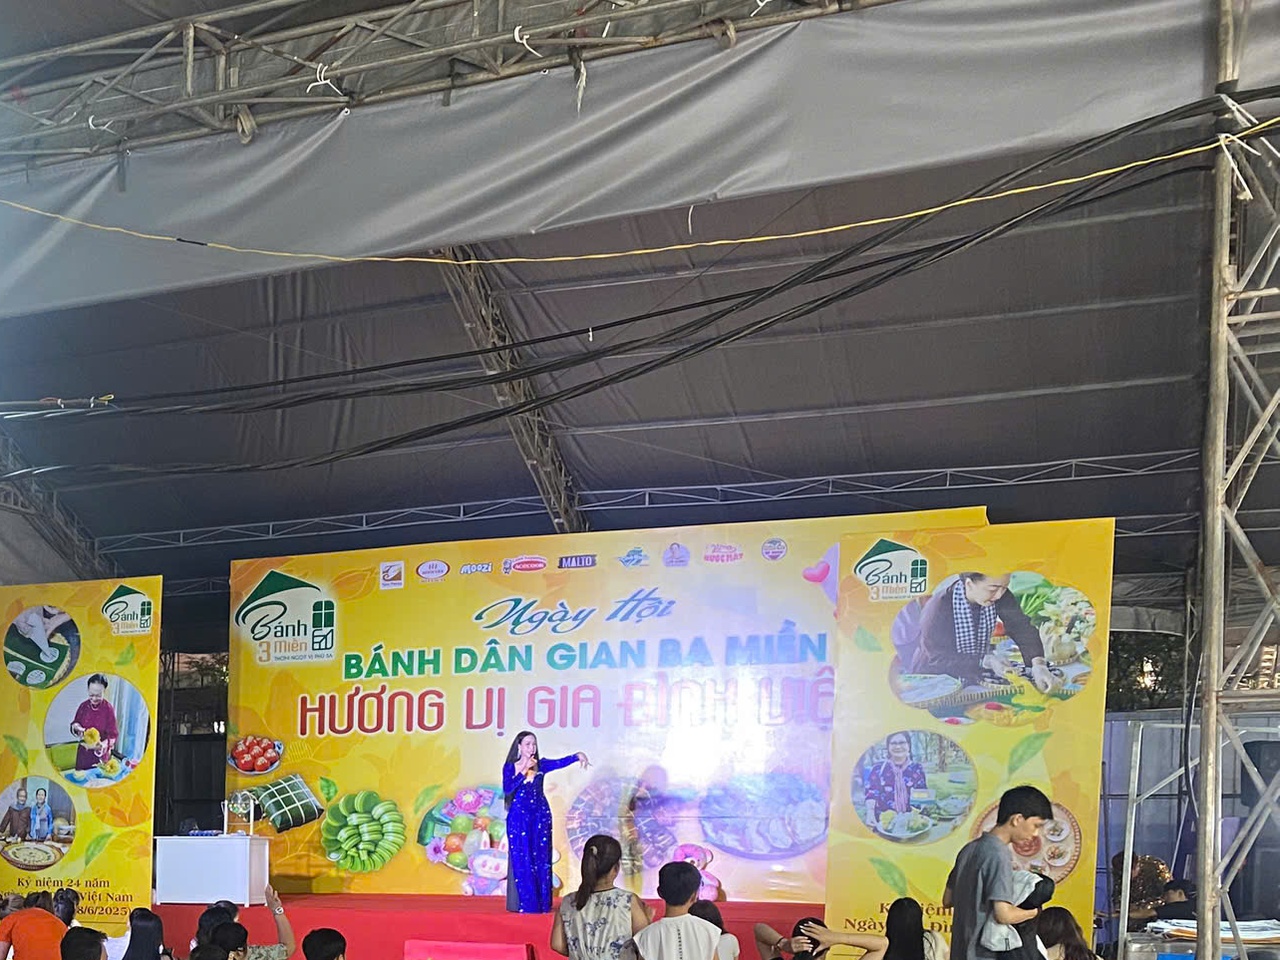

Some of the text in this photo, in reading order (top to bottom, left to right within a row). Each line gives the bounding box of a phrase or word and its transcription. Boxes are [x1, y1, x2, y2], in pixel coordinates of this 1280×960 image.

[561, 556, 593, 568] MALTO
[858, 558, 908, 586] Bánh
[870, 586, 880, 600] 3
[105, 600, 139, 623] Bánh
[241, 600, 308, 641] Bánh
[474, 587, 677, 636] Ngày Hội
[258, 640, 272, 663] 3
[343, 619, 828, 680] BÁNH DÂN GIAN BA MIỀN
[298, 684, 444, 736] HƯƠNG
[465, 687, 505, 737] VỊ
[527, 685, 602, 729] GIA
[757, 665, 834, 732] VIỆ
[17, 876, 110, 889] Kỷ niệm 24 năm
[106, 892, 133, 903] Nam
[843, 917, 886, 932] Ngày
